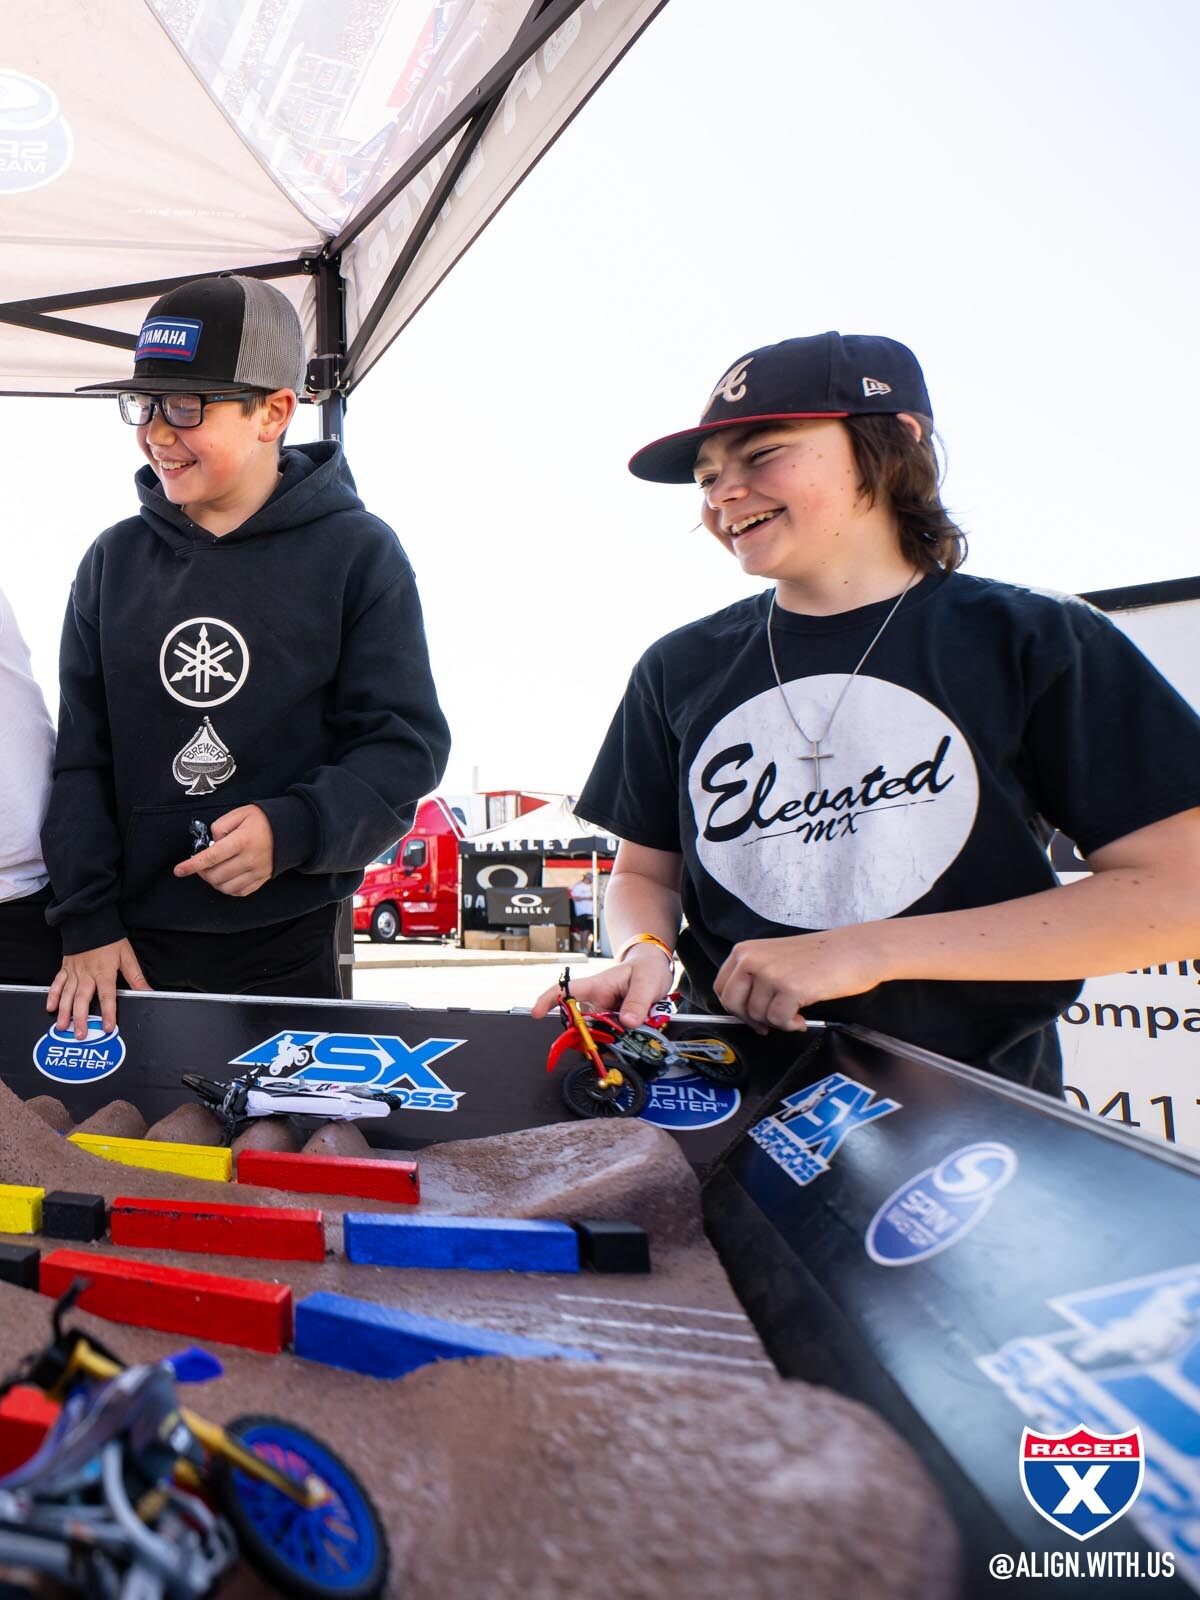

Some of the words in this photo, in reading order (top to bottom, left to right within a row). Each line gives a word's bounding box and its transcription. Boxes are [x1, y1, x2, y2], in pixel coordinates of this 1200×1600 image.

[144, 328, 187, 346] YAMAHA
[184, 742, 225, 762] BREWER
[701, 735, 954, 843] Elevated
[474, 838, 571, 853] OAKLEY
[504, 906, 552, 915] OAKLEY
[1060, 1002, 1200, 1039] ompa
[48, 1046, 110, 1061] SPIN
[651, 1085, 716, 1101] PIN
[900, 1189, 959, 1234] SPIN
